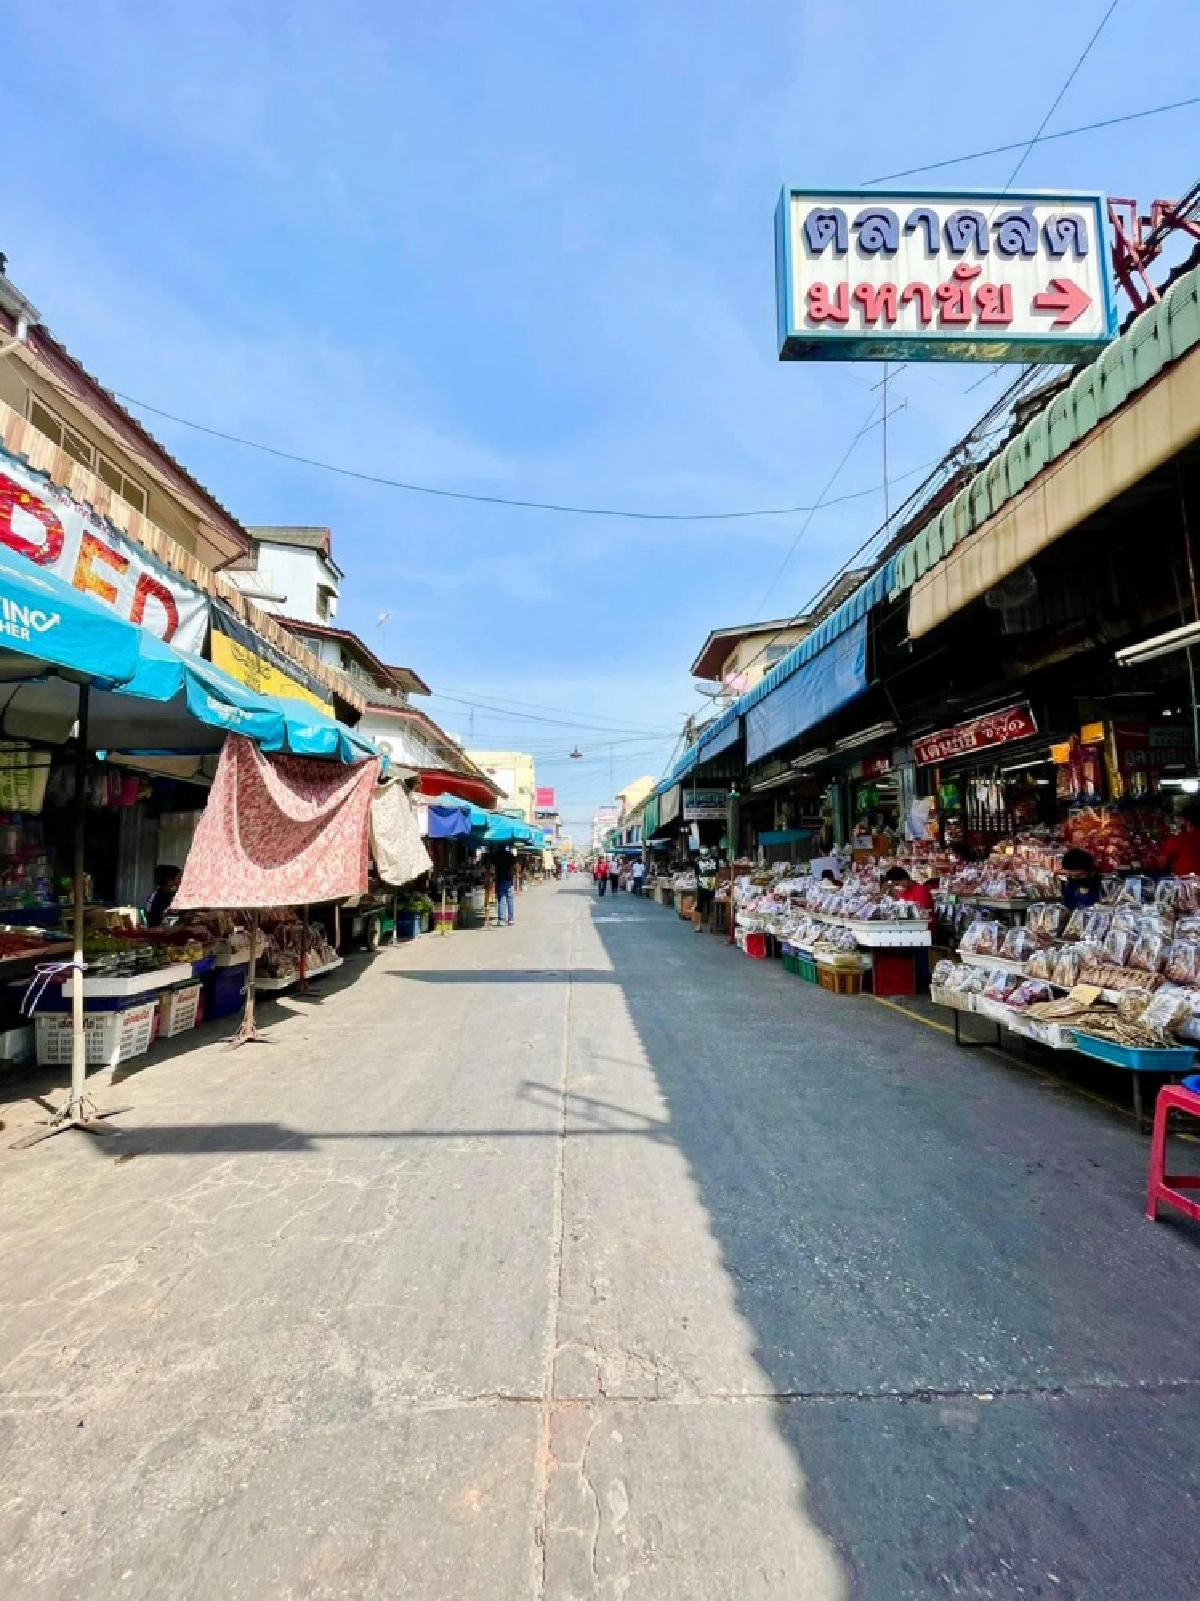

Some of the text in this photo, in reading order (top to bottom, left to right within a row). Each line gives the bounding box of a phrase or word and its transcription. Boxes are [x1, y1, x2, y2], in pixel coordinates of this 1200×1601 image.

[804, 206, 1089, 256] ตลาดสด
[807, 263, 1014, 325] มหาชัย
[0, 596, 61, 632] ING
